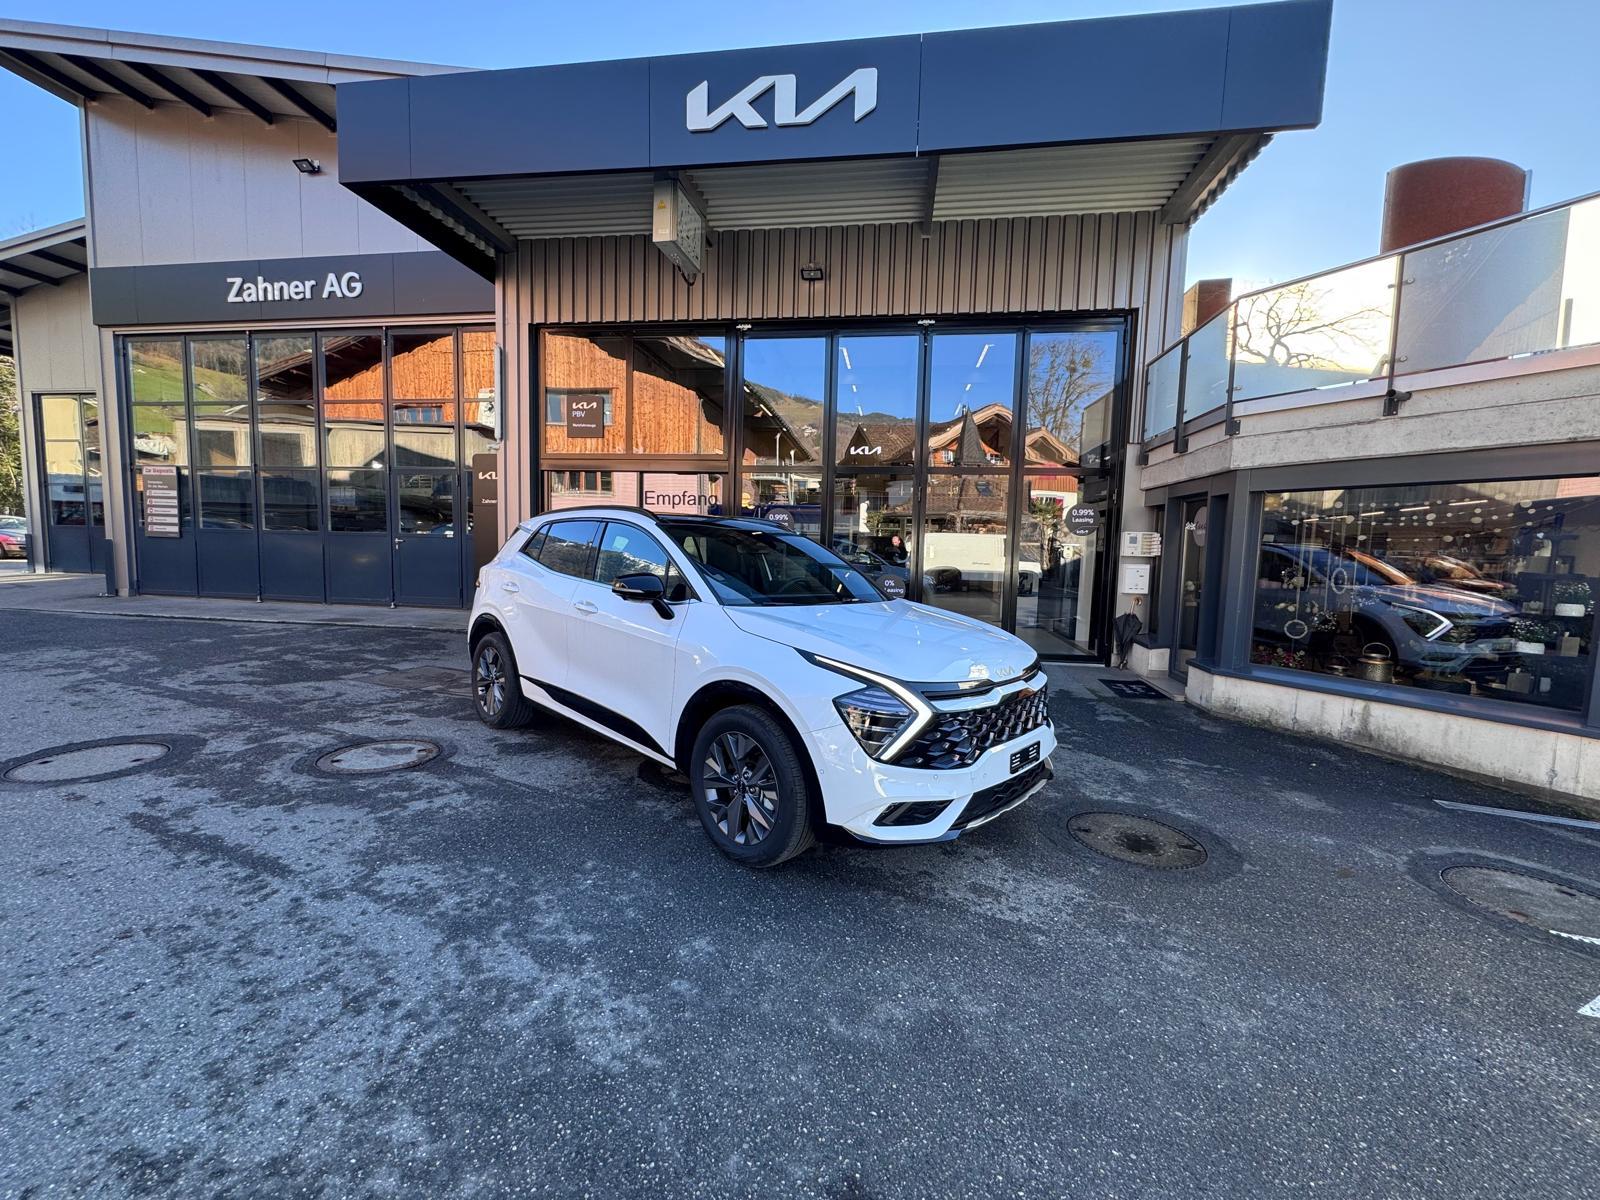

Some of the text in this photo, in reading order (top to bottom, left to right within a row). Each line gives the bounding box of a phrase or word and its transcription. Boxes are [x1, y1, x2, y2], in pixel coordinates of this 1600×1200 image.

[686, 67, 878, 132] KIA
[226, 271, 363, 303] Zahner AG
[572, 401, 597, 409] KIA
[572, 410, 586, 418] PBV
[850, 445, 882, 455] KIA
[644, 490, 718, 509] Empfang
[1071, 508, 1095, 516] 0.99%
[768, 513, 789, 521] 0.99%
[1071, 516, 1094, 524] Leasing
